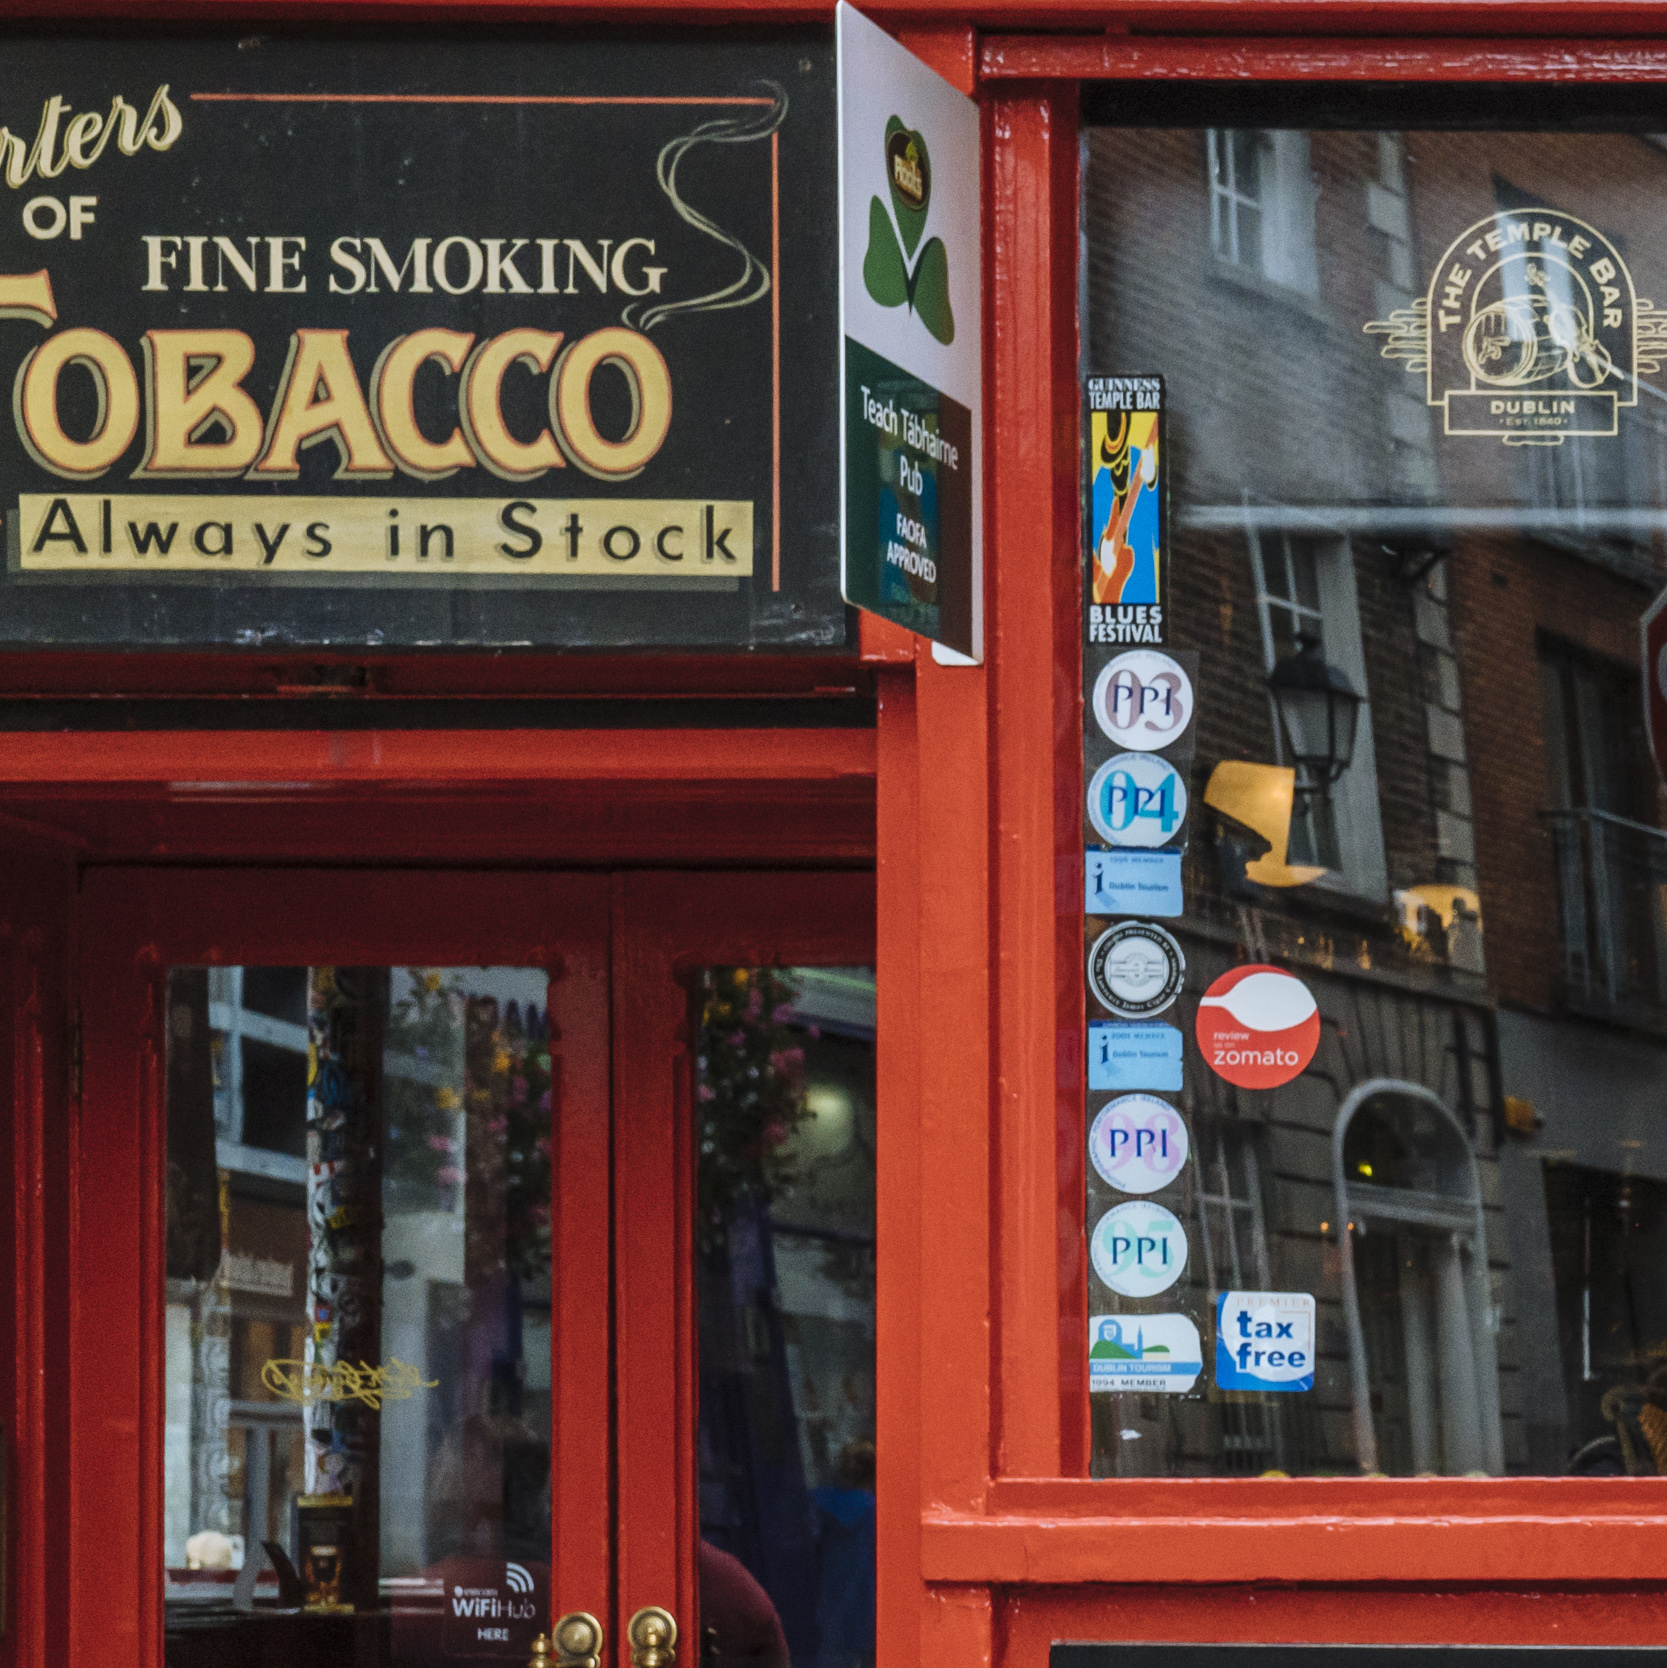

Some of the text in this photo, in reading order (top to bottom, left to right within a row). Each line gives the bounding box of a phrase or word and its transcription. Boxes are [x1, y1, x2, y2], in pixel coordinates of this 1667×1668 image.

[23, 196, 98, 240] OF
[141, 235, 668, 296] FINE SMOKING
[1439, 222, 1623, 332] THE TEMPLE BAR
[1088, 378, 1161, 392] GUINNESS
[861, 384, 898, 437] Teach
[1089, 392, 1161, 410] TEMPLE BAR
[1491, 400, 1575, 415] DUBLIN
[900, 455, 923, 496] Pub
[31, 498, 738, 567] Always in Stock
[887, 540, 936, 584] APPROVED
[1089, 605, 1162, 624] BLUES
[1089, 624, 1163, 643] FESTIVAL
[1112, 684, 1171, 716] PPI
[1108, 785, 1166, 817] PPI
[1213, 1031, 1250, 1042] review
[1214, 1047, 1298, 1067] zomato
[1110, 1129, 1168, 1158] PPI
[1112, 1236, 1168, 1265] PPI
[1236, 1310, 1293, 1339] tax
[1236, 1342, 1307, 1370] free
[478, 1628, 509, 1640] HERE
